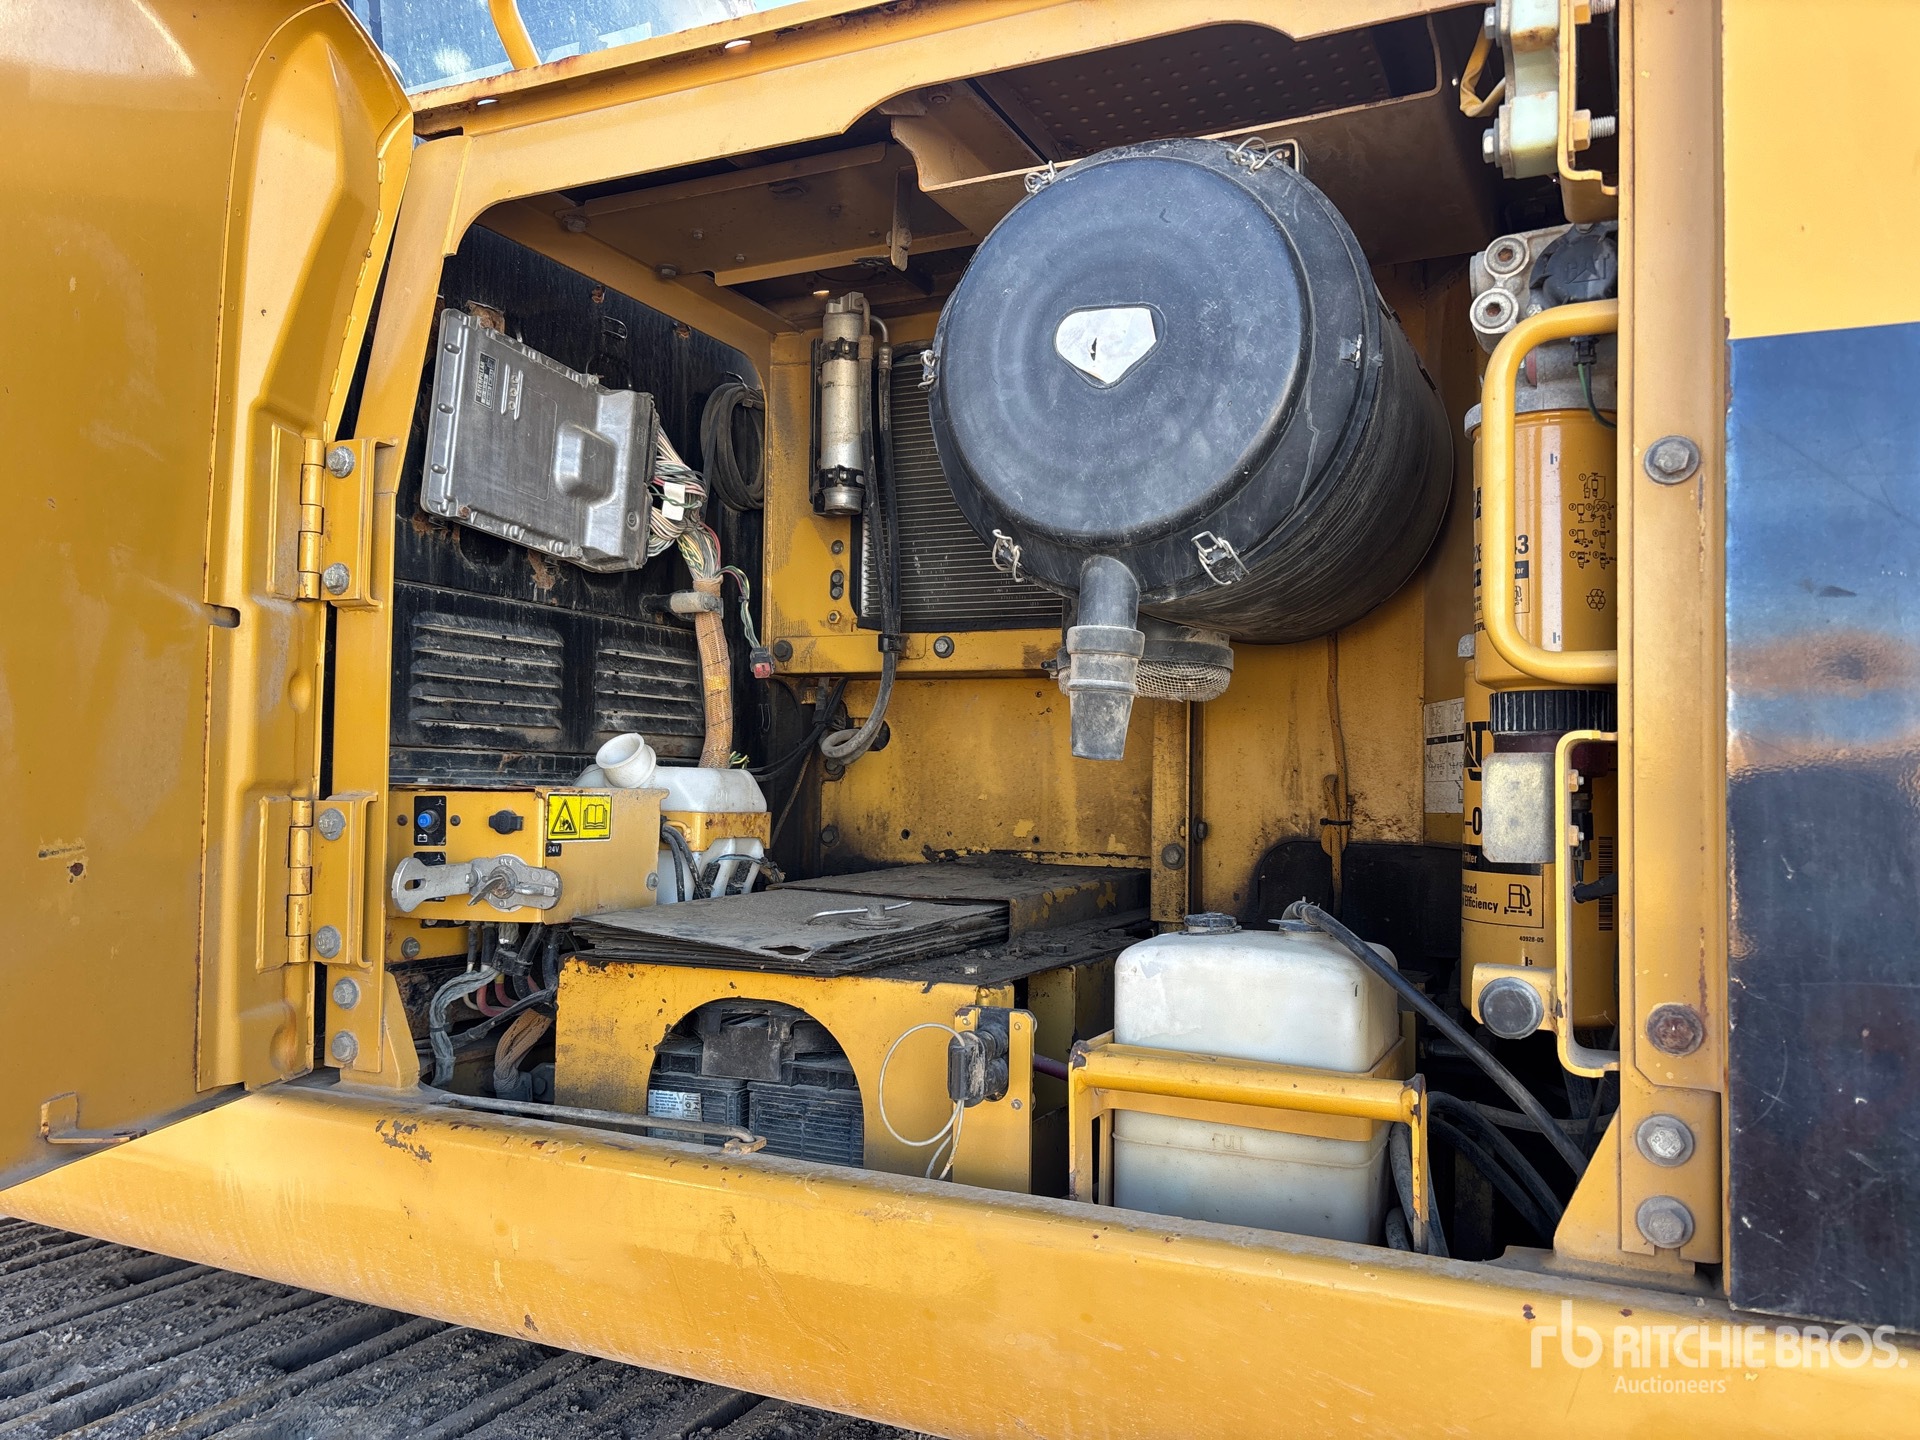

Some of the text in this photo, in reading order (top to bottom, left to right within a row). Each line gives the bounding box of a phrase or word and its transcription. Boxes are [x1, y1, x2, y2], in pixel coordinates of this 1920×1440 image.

[1464, 721, 1489, 767] AT
[548, 845, 560, 854] 24V
[1465, 896, 1499, 914] Efficiency
[1213, 1132, 1247, 1152] FULL
